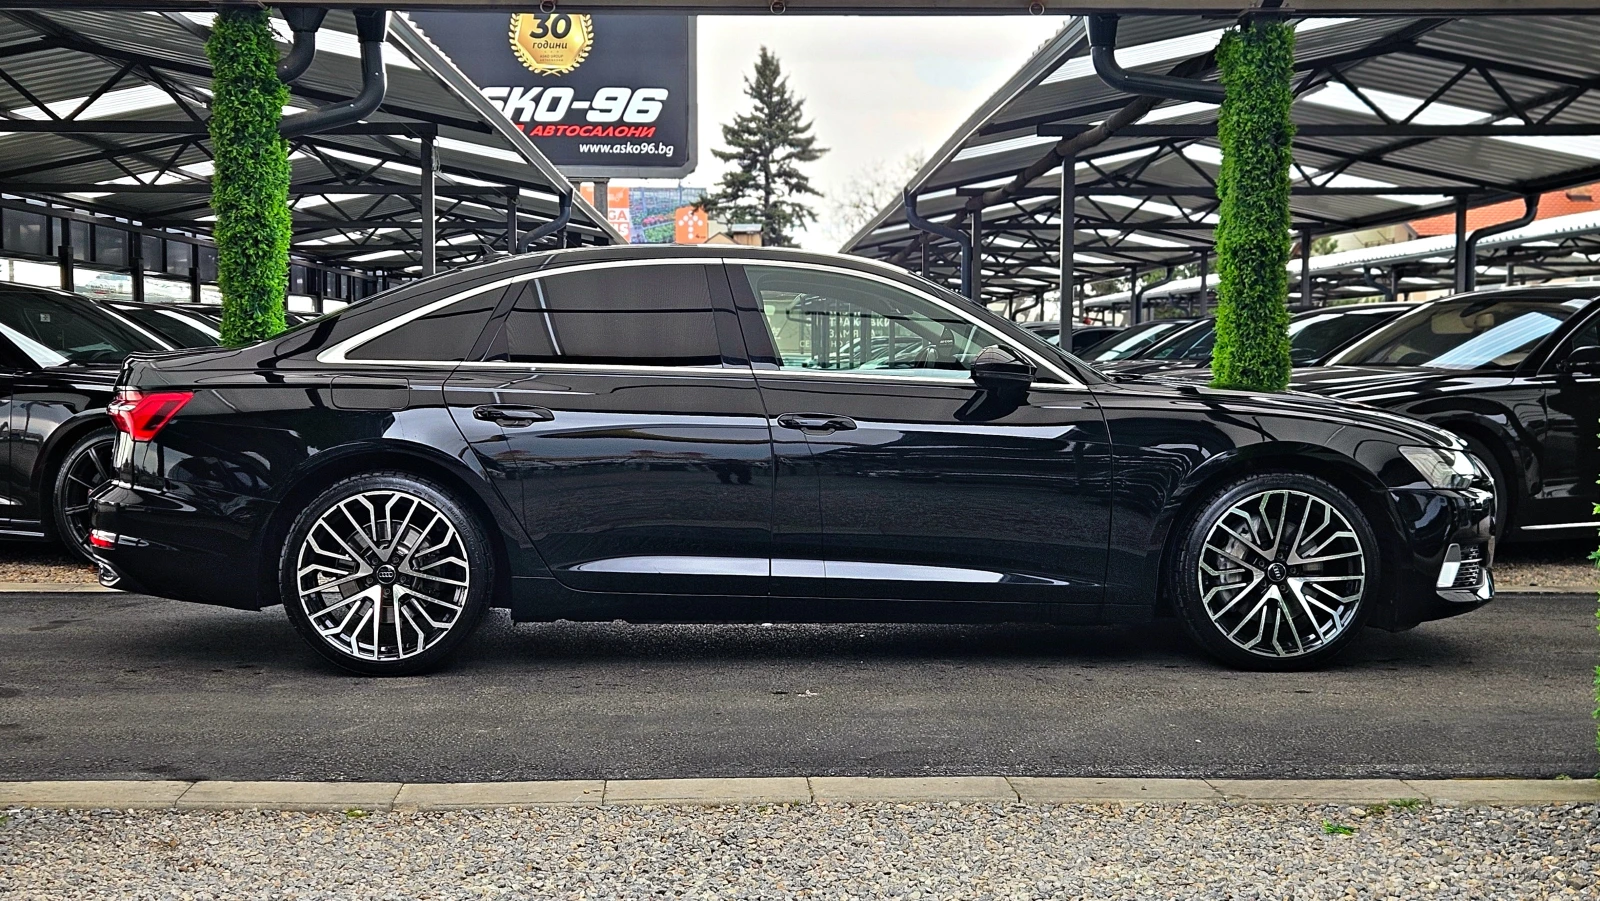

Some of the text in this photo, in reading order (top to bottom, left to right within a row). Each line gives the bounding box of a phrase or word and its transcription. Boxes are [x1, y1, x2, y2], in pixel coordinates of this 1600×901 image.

[529, 13, 572, 39] 30
[532, 40, 568, 49] години
[480, 86, 669, 123] SKO-96
[529, 125, 656, 138] АВТОСАЛОНИ
[579, 142, 674, 157] www.asko96.bg
